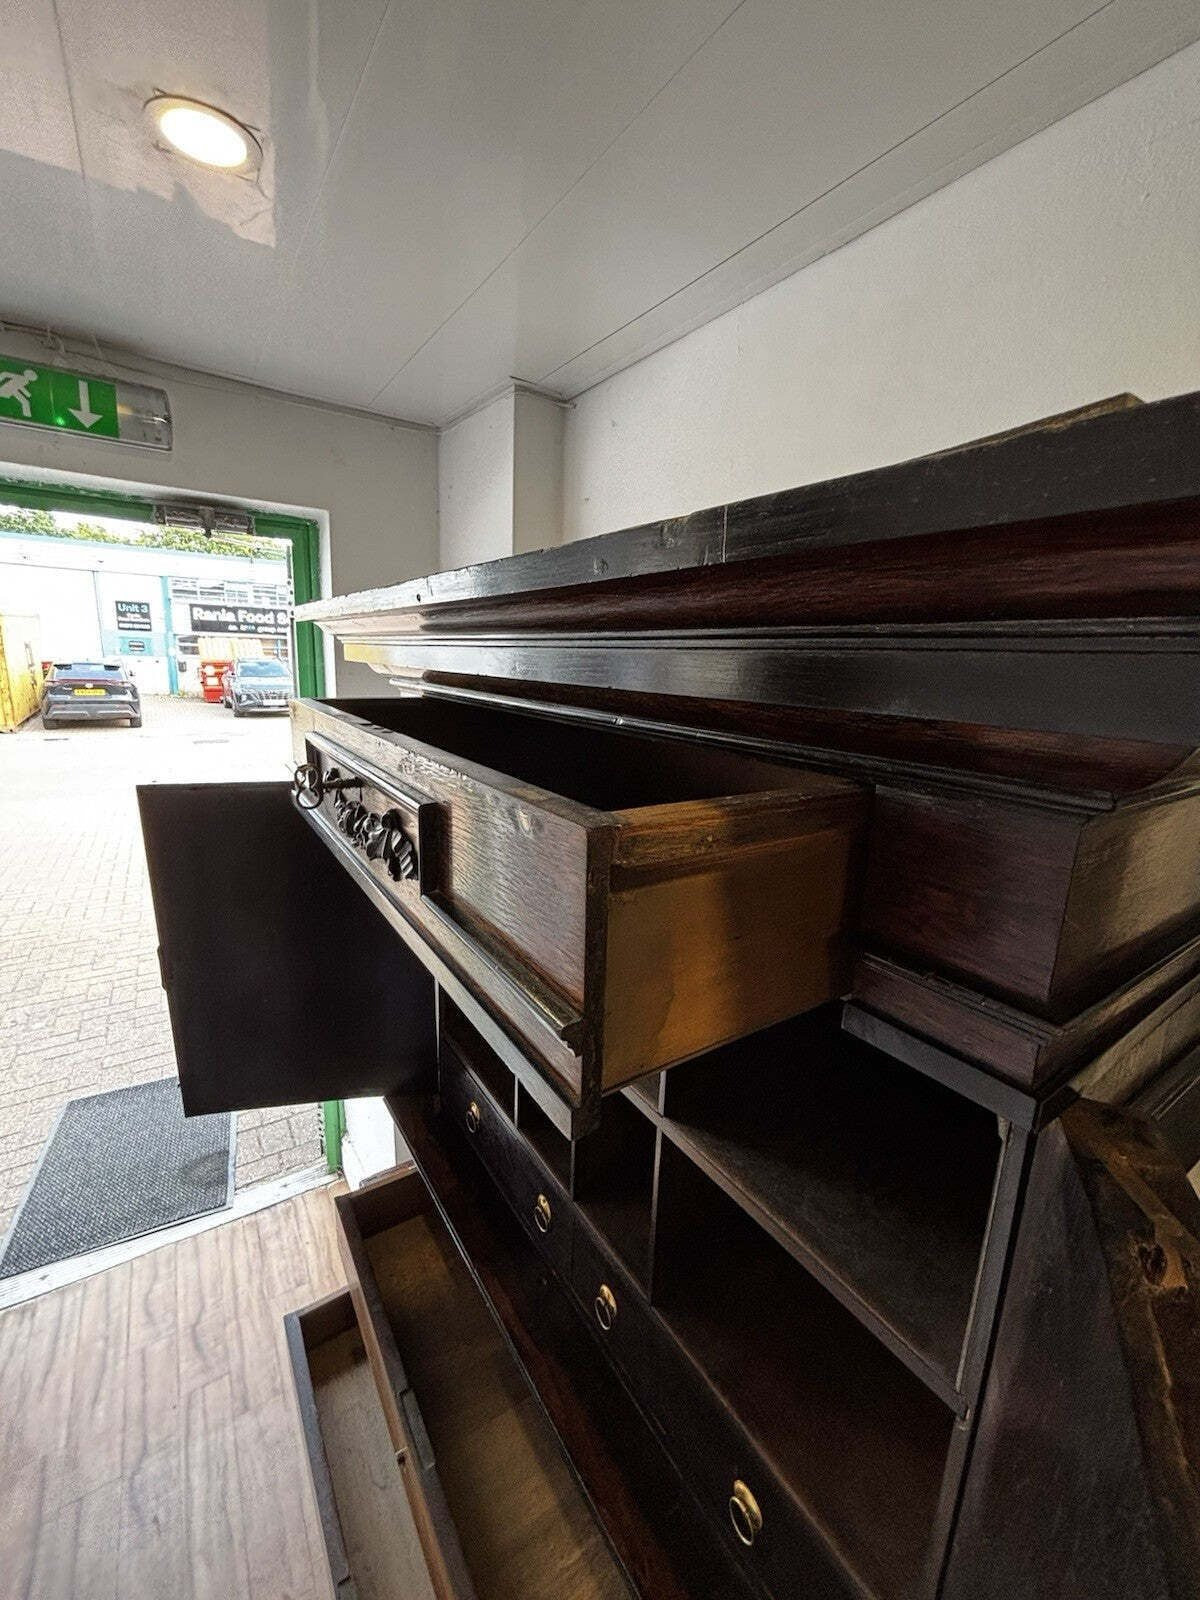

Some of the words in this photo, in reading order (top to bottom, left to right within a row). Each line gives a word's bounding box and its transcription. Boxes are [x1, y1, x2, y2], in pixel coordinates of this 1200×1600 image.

[118, 603, 139, 612] Unit
[141, 605, 148, 613] 3
[238, 609, 275, 624] Food
